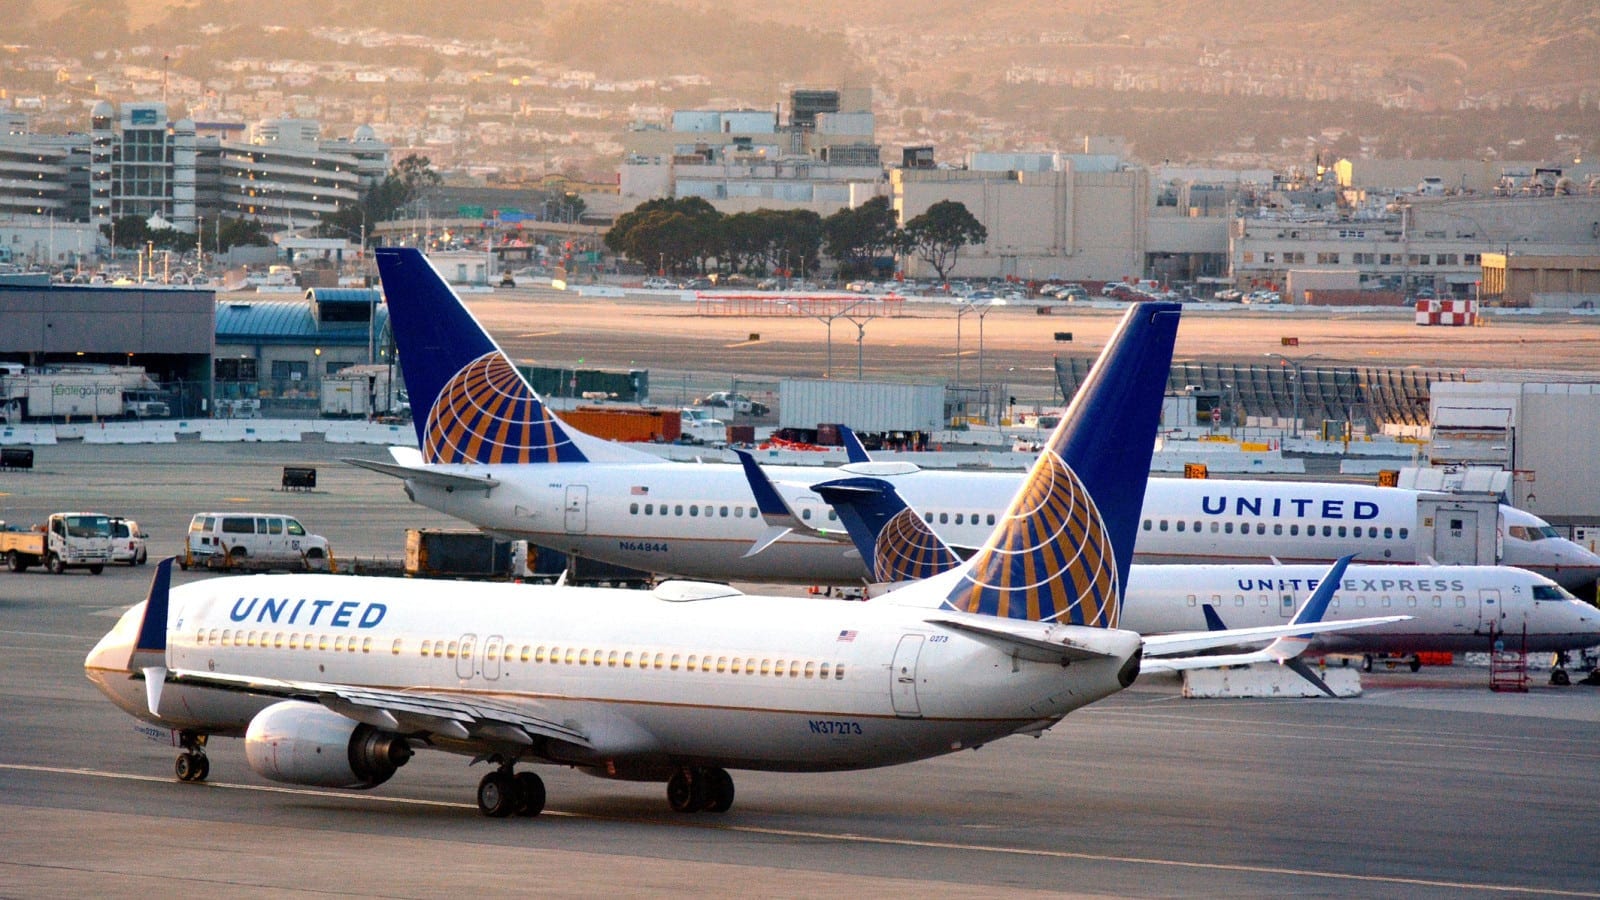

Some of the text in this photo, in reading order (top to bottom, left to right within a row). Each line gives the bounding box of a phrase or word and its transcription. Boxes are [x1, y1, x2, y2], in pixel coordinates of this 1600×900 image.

[1202, 496, 1379, 520] UNITED
[620, 541, 668, 552] N64844
[1238, 579, 1464, 592] UNITE EXPRESS
[230, 597, 388, 629] UNITED
[930, 635, 949, 643] 0273
[808, 720, 862, 734] N37273
